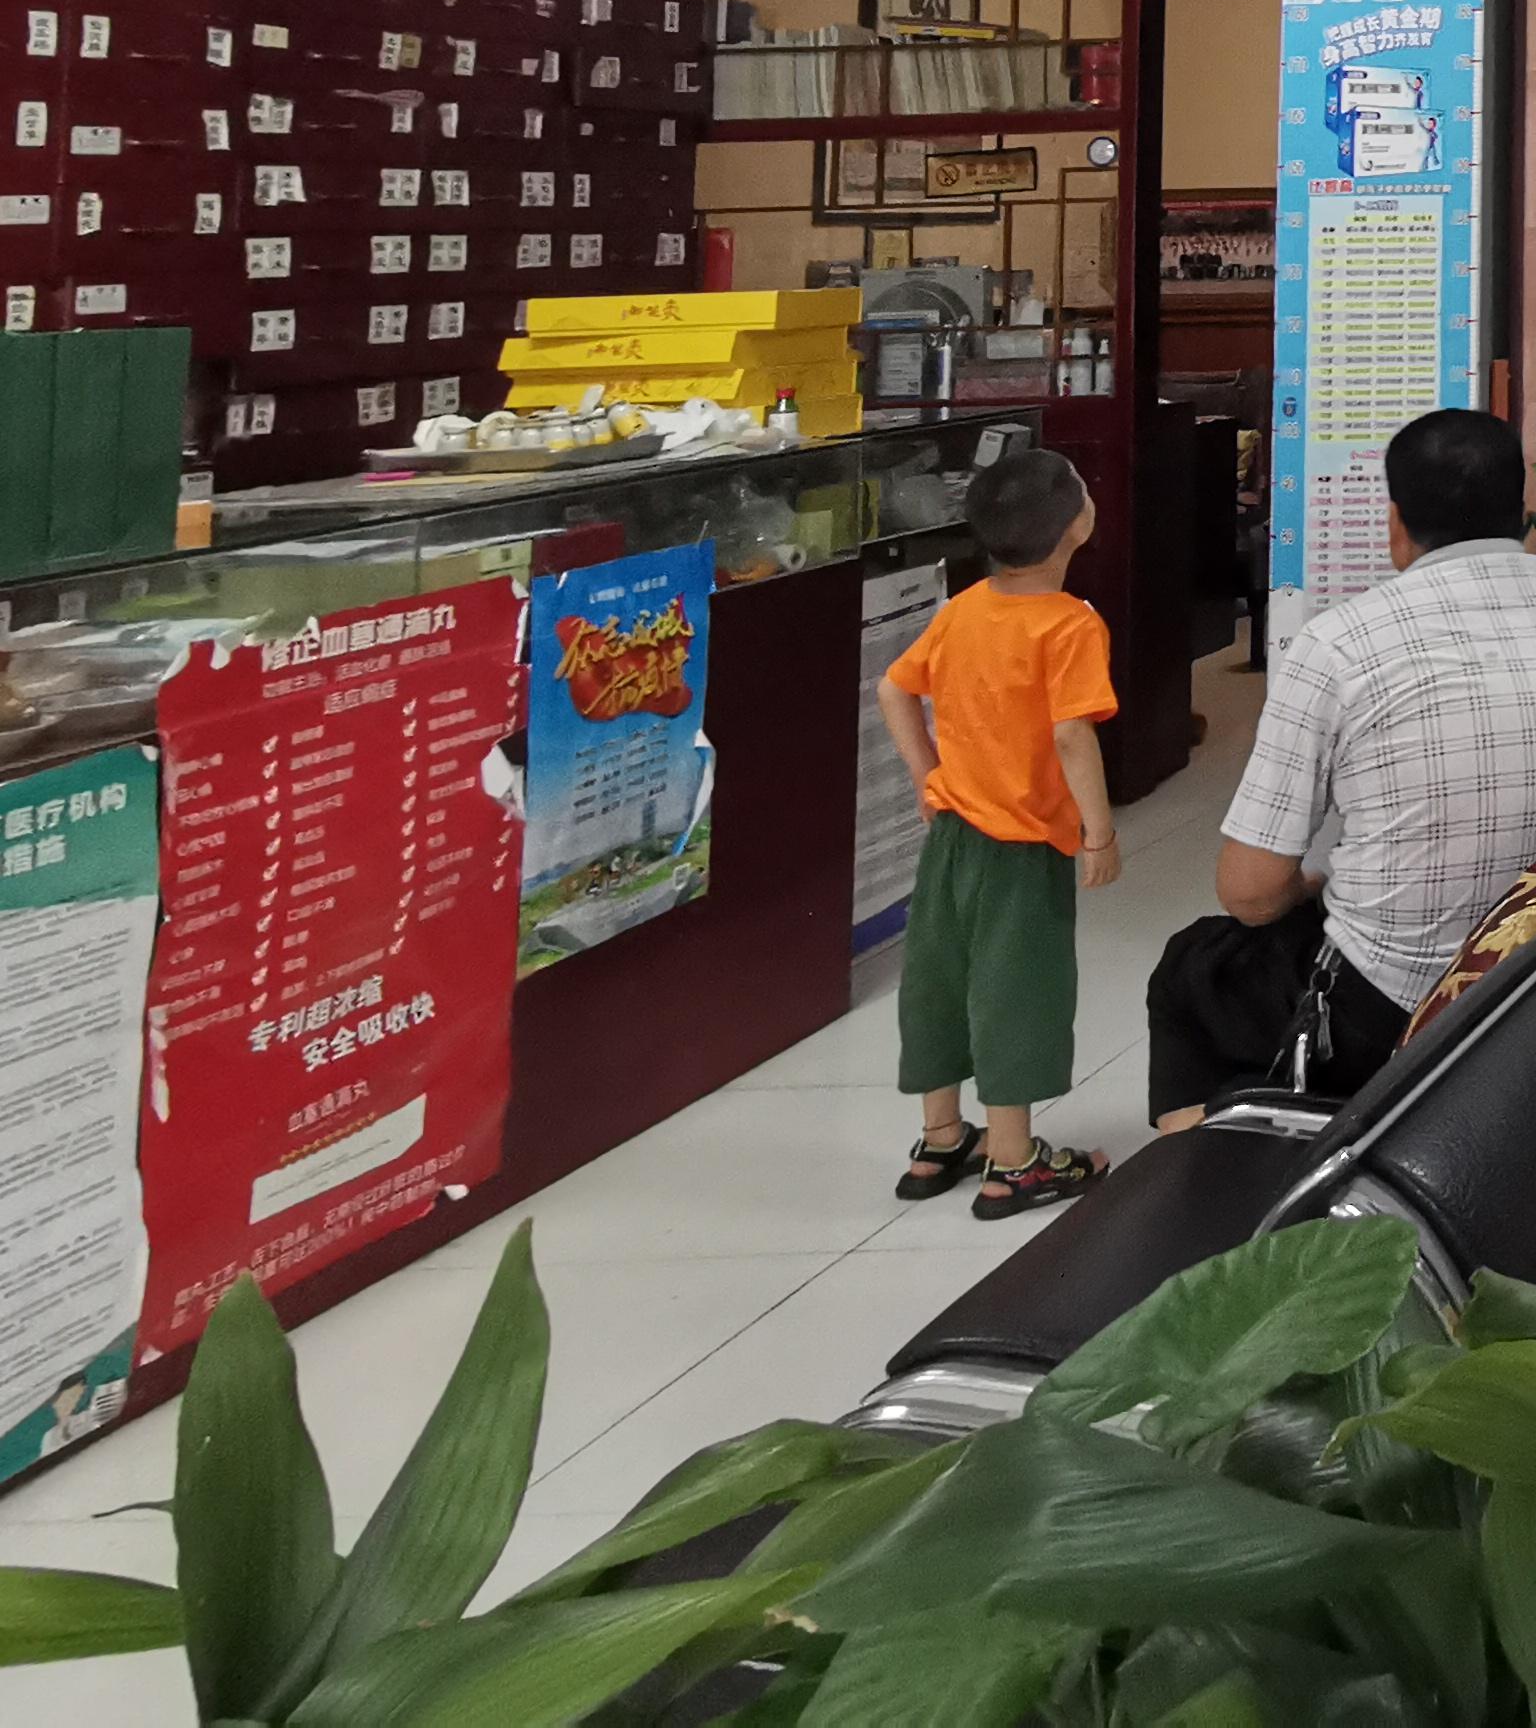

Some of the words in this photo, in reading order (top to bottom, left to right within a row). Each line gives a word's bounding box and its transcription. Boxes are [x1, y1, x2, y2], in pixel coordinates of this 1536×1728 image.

[303, 992, 435, 1072] 安全吸收快
